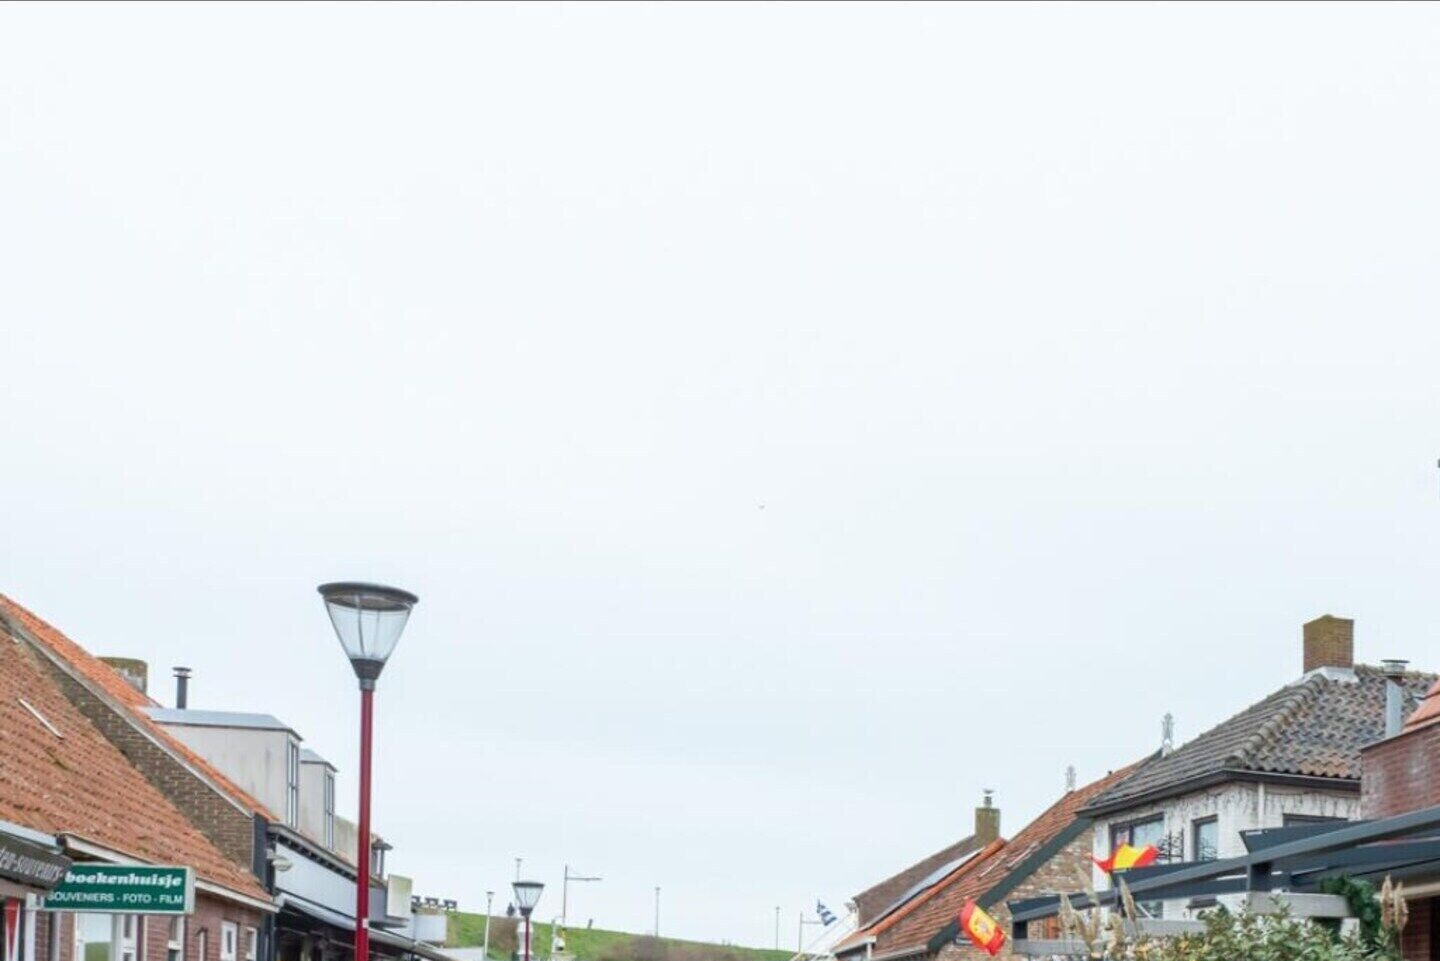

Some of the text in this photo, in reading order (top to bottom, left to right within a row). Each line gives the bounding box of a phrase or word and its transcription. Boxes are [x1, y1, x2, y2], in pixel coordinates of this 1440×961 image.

[65, 870, 182, 888] boekenhuisje
[123, 893, 150, 904] FOTO
[159, 894, 183, 904] FILM
